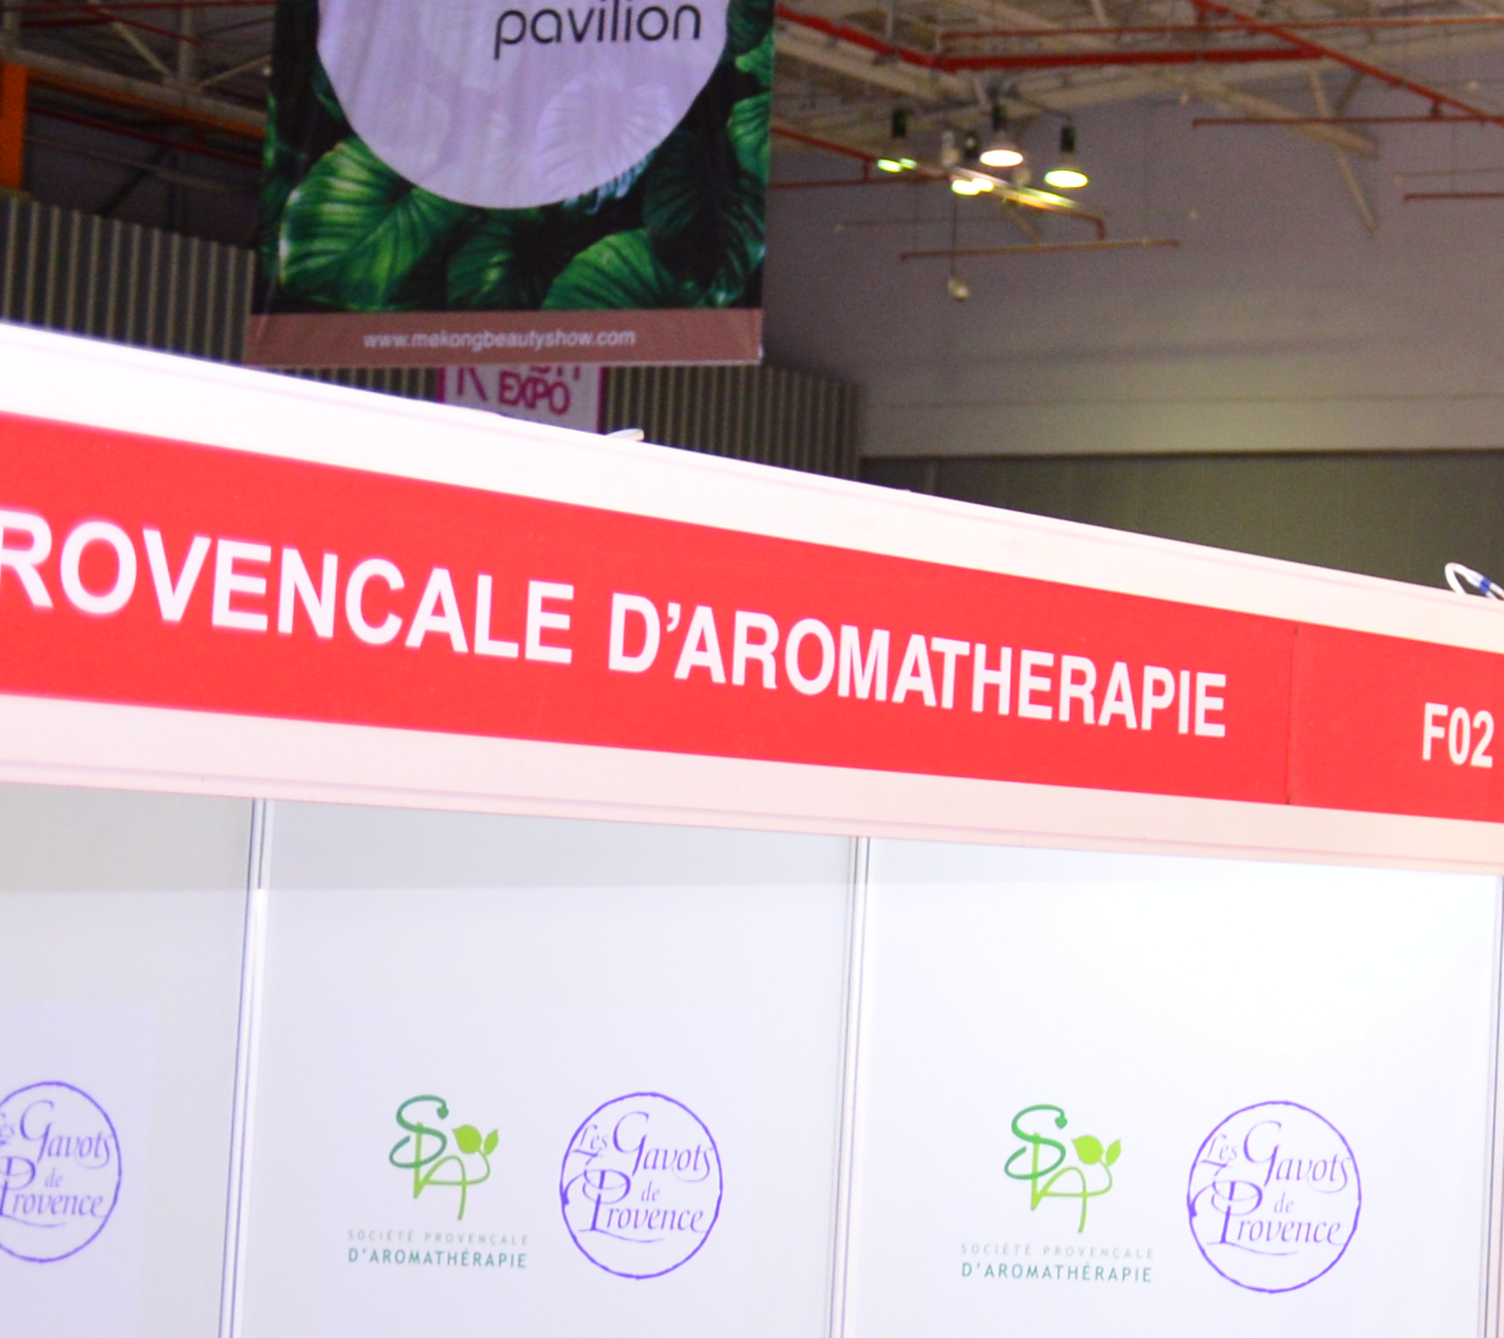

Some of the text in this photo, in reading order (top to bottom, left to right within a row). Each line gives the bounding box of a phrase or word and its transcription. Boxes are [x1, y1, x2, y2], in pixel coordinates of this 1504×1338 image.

[363, 326, 636, 351] www.mekongbeautyshow.com
[608, 591, 1226, 738] D'AROMATHERAPIE
[1423, 703, 1494, 768] F02
[611, 1110, 713, 1181] Gavots
[1243, 1121, 1353, 1192] Gavots
[45, 1169, 63, 1190] de
[585, 1168, 707, 1236] Provence
[641, 1183, 661, 1204] de
[1210, 1179, 1343, 1246] Provence
[1274, 1193, 1294, 1215] de
[348, 1247, 528, 1269] D'AROMATHÉRAPIE
[961, 1261, 1153, 1283] D'AROMATHÉRAPIE
